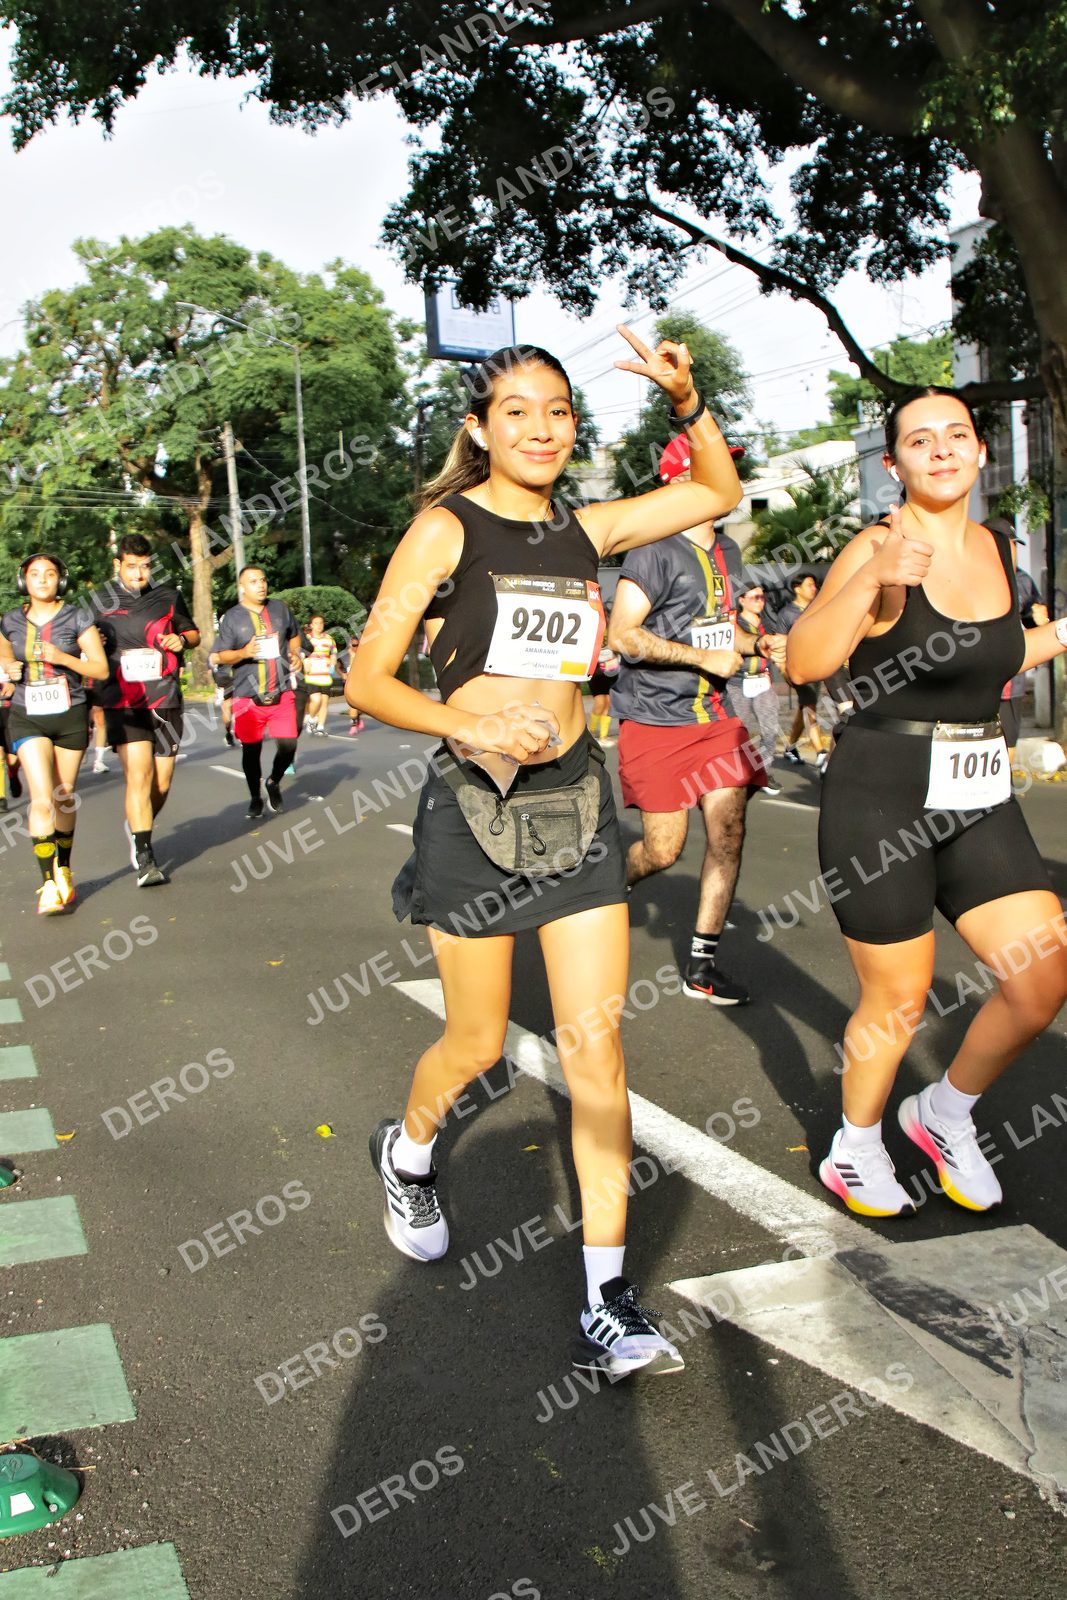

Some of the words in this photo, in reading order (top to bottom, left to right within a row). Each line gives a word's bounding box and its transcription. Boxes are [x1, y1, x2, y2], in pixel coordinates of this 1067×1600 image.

[511, 607, 581, 645] 9202
[696, 629, 732, 650] 13179
[31, 689, 59, 703] 8100
[950, 749, 1001, 779] 1016
